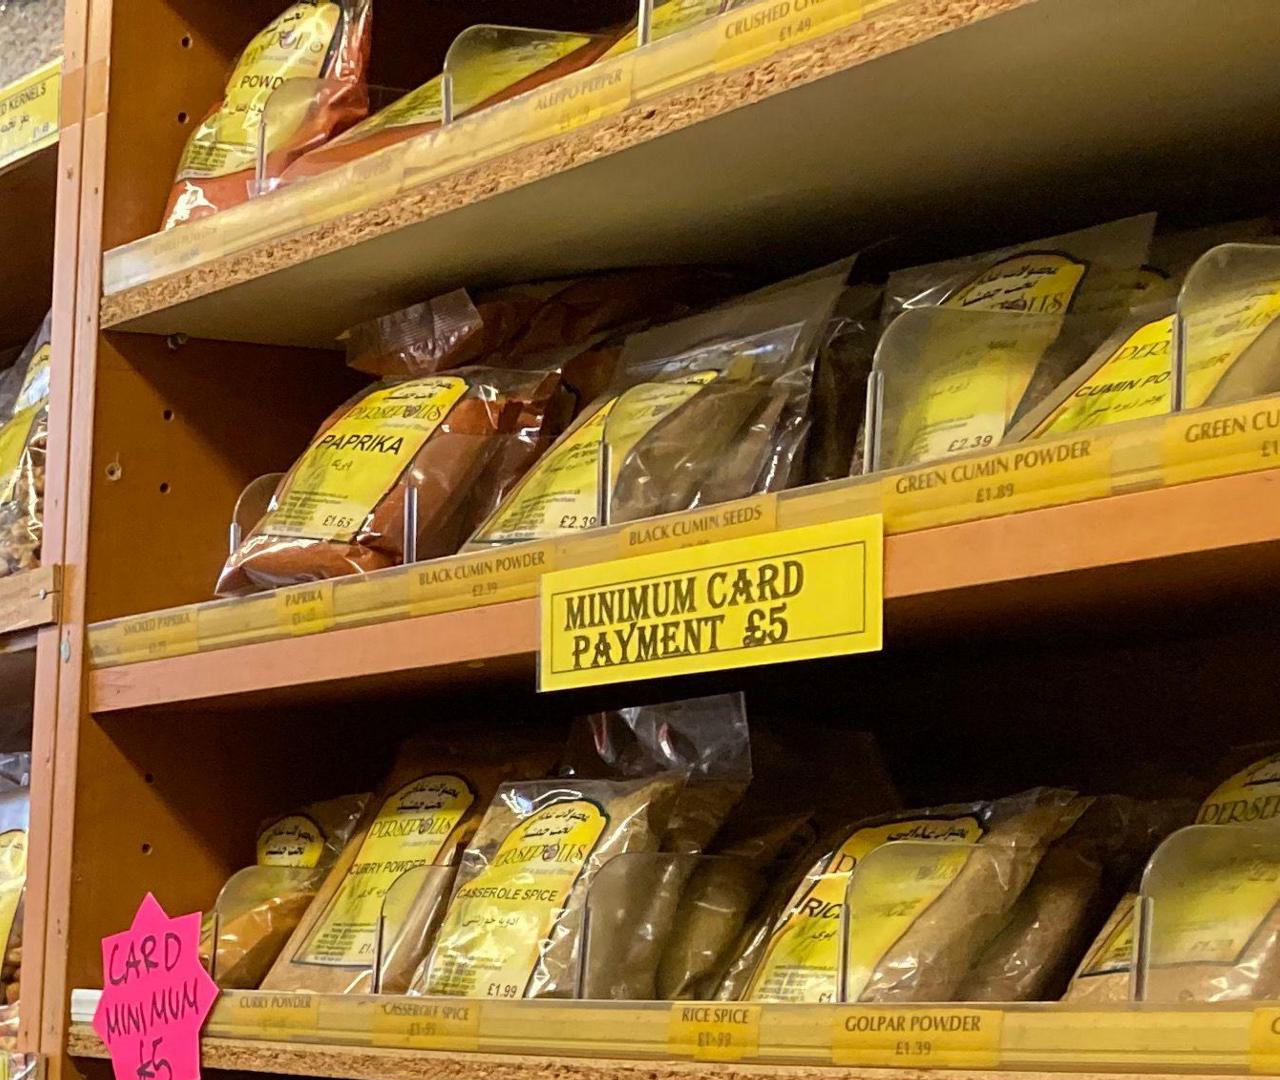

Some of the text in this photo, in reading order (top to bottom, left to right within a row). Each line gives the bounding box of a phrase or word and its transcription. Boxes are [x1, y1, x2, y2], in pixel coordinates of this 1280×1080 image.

[724, 1, 791, 40] CRUSHED
[8, 82, 48, 115] KERNELS
[1075, 376, 1131, 399] CUMIN
[1184, 415, 1248, 444] GREEN
[315, 434, 405, 455] PAPRIKA
[946, 433, 994, 453] £2.39
[894, 439, 1092, 495] GREEN CUMIN POWDER
[628, 505, 763, 547] BLACK CUMIN SEEDS
[418, 549, 546, 586] BLACK CUMIN POWDER
[284, 588, 324, 608] PAPRIKA
[563, 559, 806, 632] MINIMUM CARD
[571, 602, 790, 670] PAYMENT £5
[368, 815, 454, 840] PERSEPOLIS
[495, 840, 586, 866] ERSEPOLIS
[348, 857, 426, 876] CURRY POWDER
[456, 887, 559, 902] CASSEROLE SPICE
[108, 932, 182, 986] CARD
[270, 995, 313, 1011] POWDER
[487, 983, 518, 999] £1.99
[105, 977, 200, 1043] MINIMUM
[440, 1005, 471, 1022] SPICE
[680, 1008, 750, 1025] RICE SPICE
[844, 1013, 981, 1033] GOLPAR POWDER
